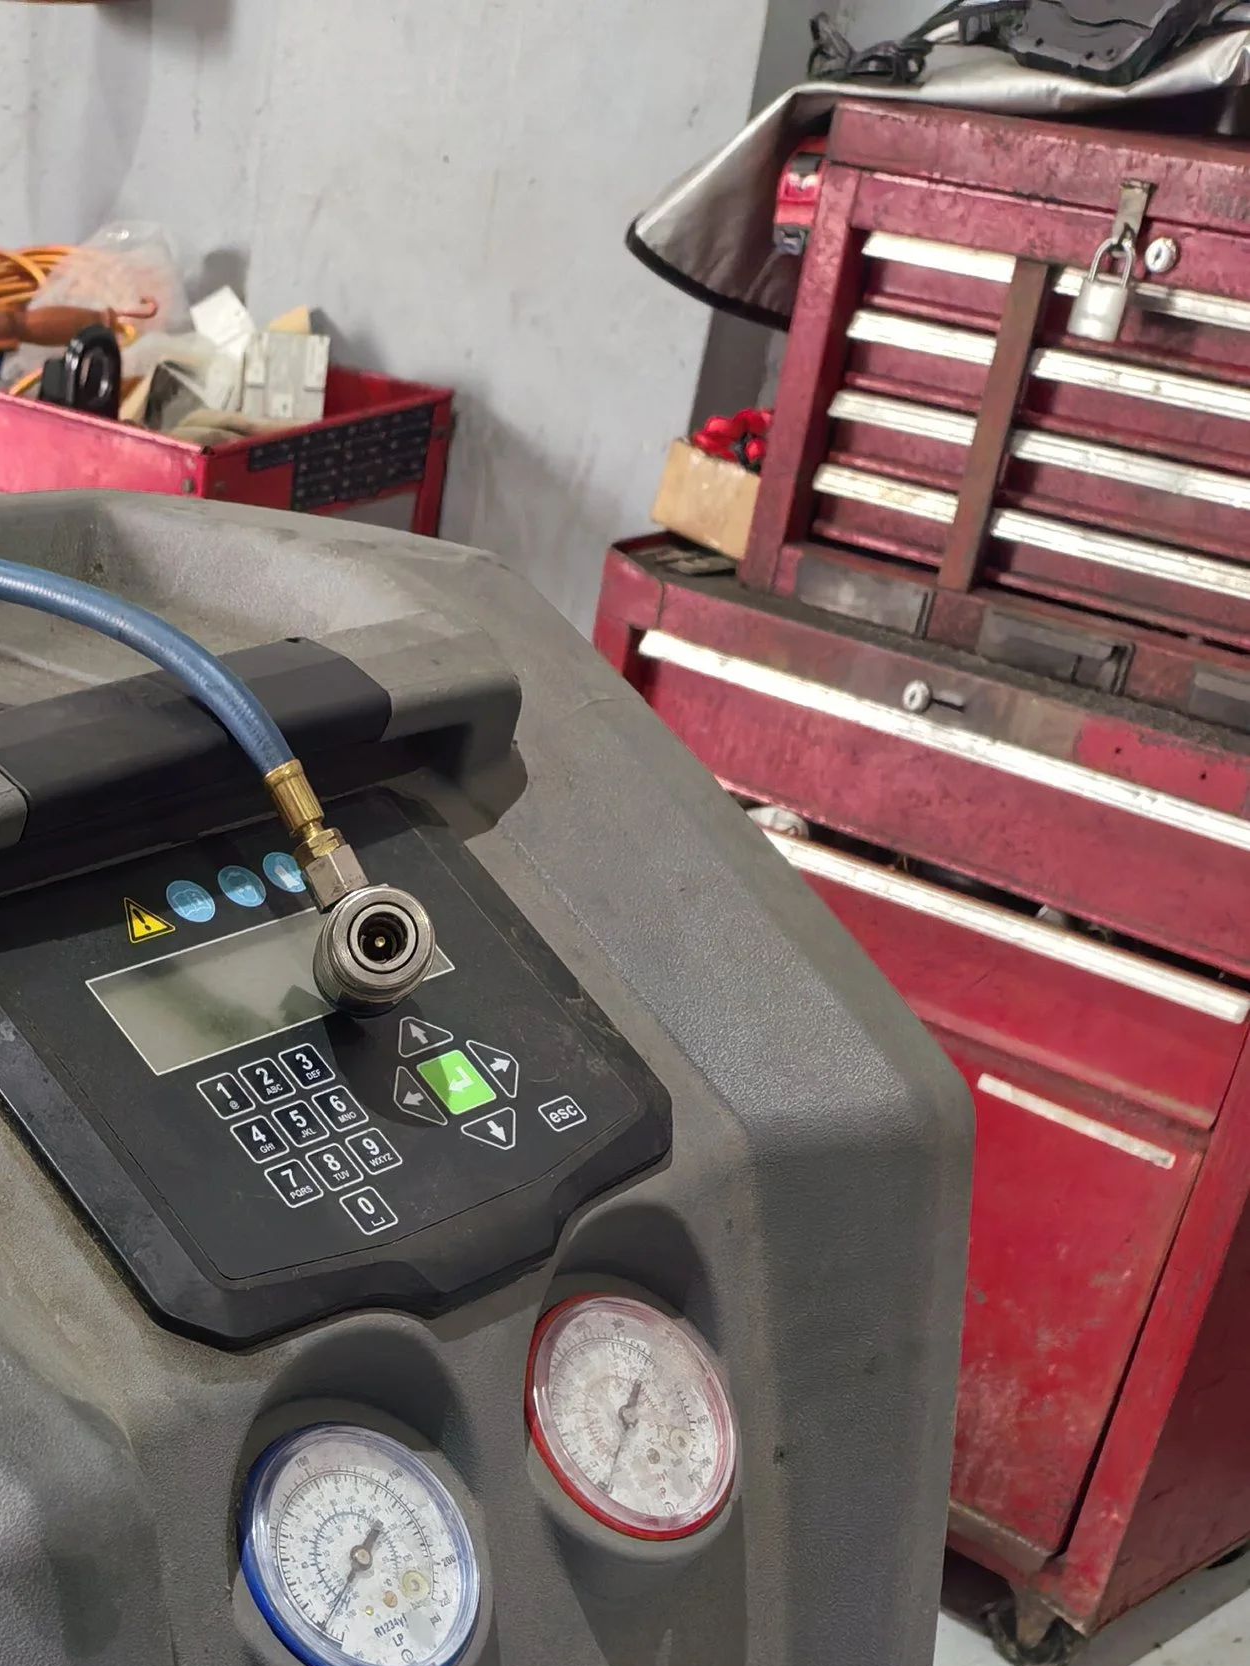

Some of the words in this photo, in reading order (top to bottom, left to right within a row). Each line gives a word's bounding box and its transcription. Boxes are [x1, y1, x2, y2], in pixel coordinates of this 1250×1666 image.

[295, 1053, 313, 1070] 3
[255, 1067, 274, 1085] 2
[305, 1069, 321, 1081] DEF
[216, 1082, 232, 1099] 1
[266, 1084, 284, 1095] ABC
[329, 1095, 346, 1112] 6
[289, 1110, 307, 1128] 5
[337, 1111, 357, 1123] MNO
[549, 1104, 578, 1123] esc
[251, 1125, 266, 1143] 4
[301, 1128, 317, 1138] JKL
[259, 1143, 276, 1154] GHI
[362, 1138, 379, 1155] 9
[323, 1153, 341, 1171] 8
[369, 1153, 394, 1167] WXYZ
[280, 1168, 297, 1188] 7
[332, 1170, 350, 1181] TUV
[290, 1186, 313, 1200] PQRS
[357, 1197, 375, 1214] 0
[442, 1554, 457, 1568] 200
[392, 1633, 405, 1648] LP
